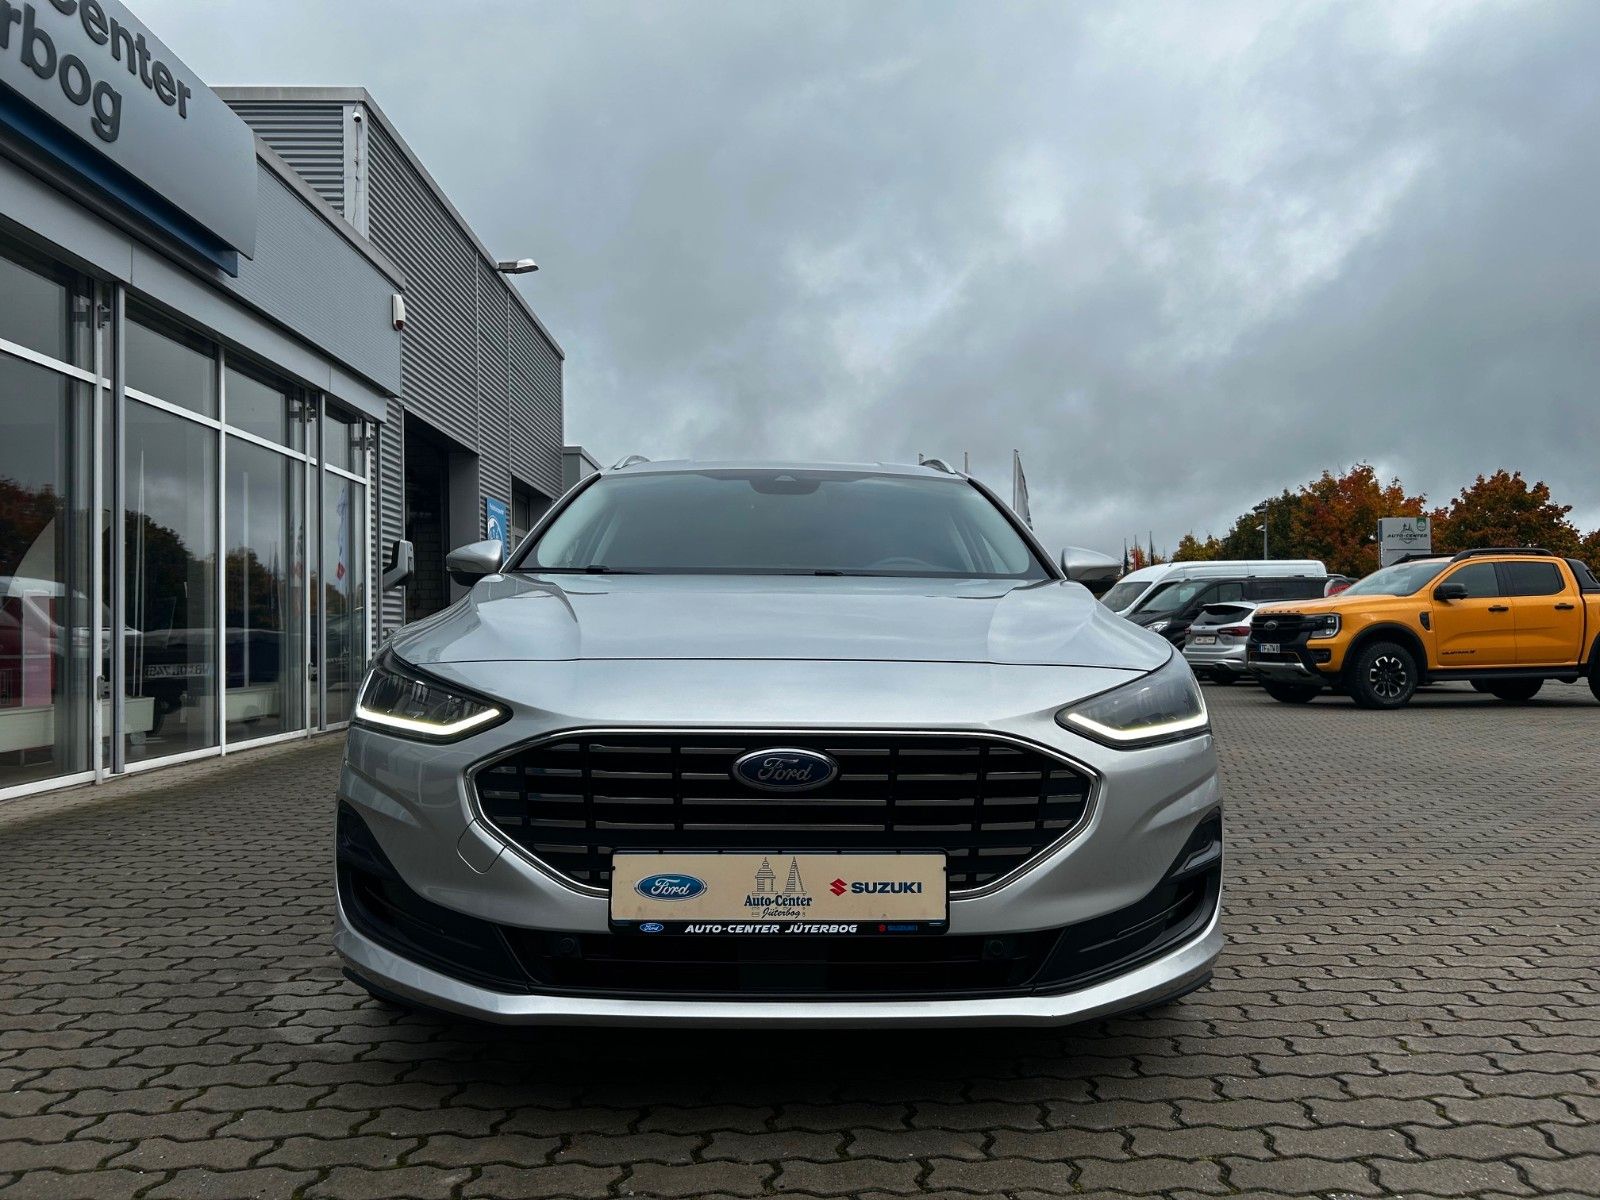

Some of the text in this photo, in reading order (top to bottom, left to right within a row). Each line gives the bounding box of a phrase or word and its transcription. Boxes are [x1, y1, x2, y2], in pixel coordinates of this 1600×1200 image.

[757, 757, 814, 781] Ford
[650, 878, 690, 896] Ford
[851, 881, 923, 894] SUZUKI
[744, 894, 813, 907] Auto-Center
[761, 906, 801, 919] Jüterbog
[684, 922, 858, 933] AUTO-CENTER JÜTERBOG
